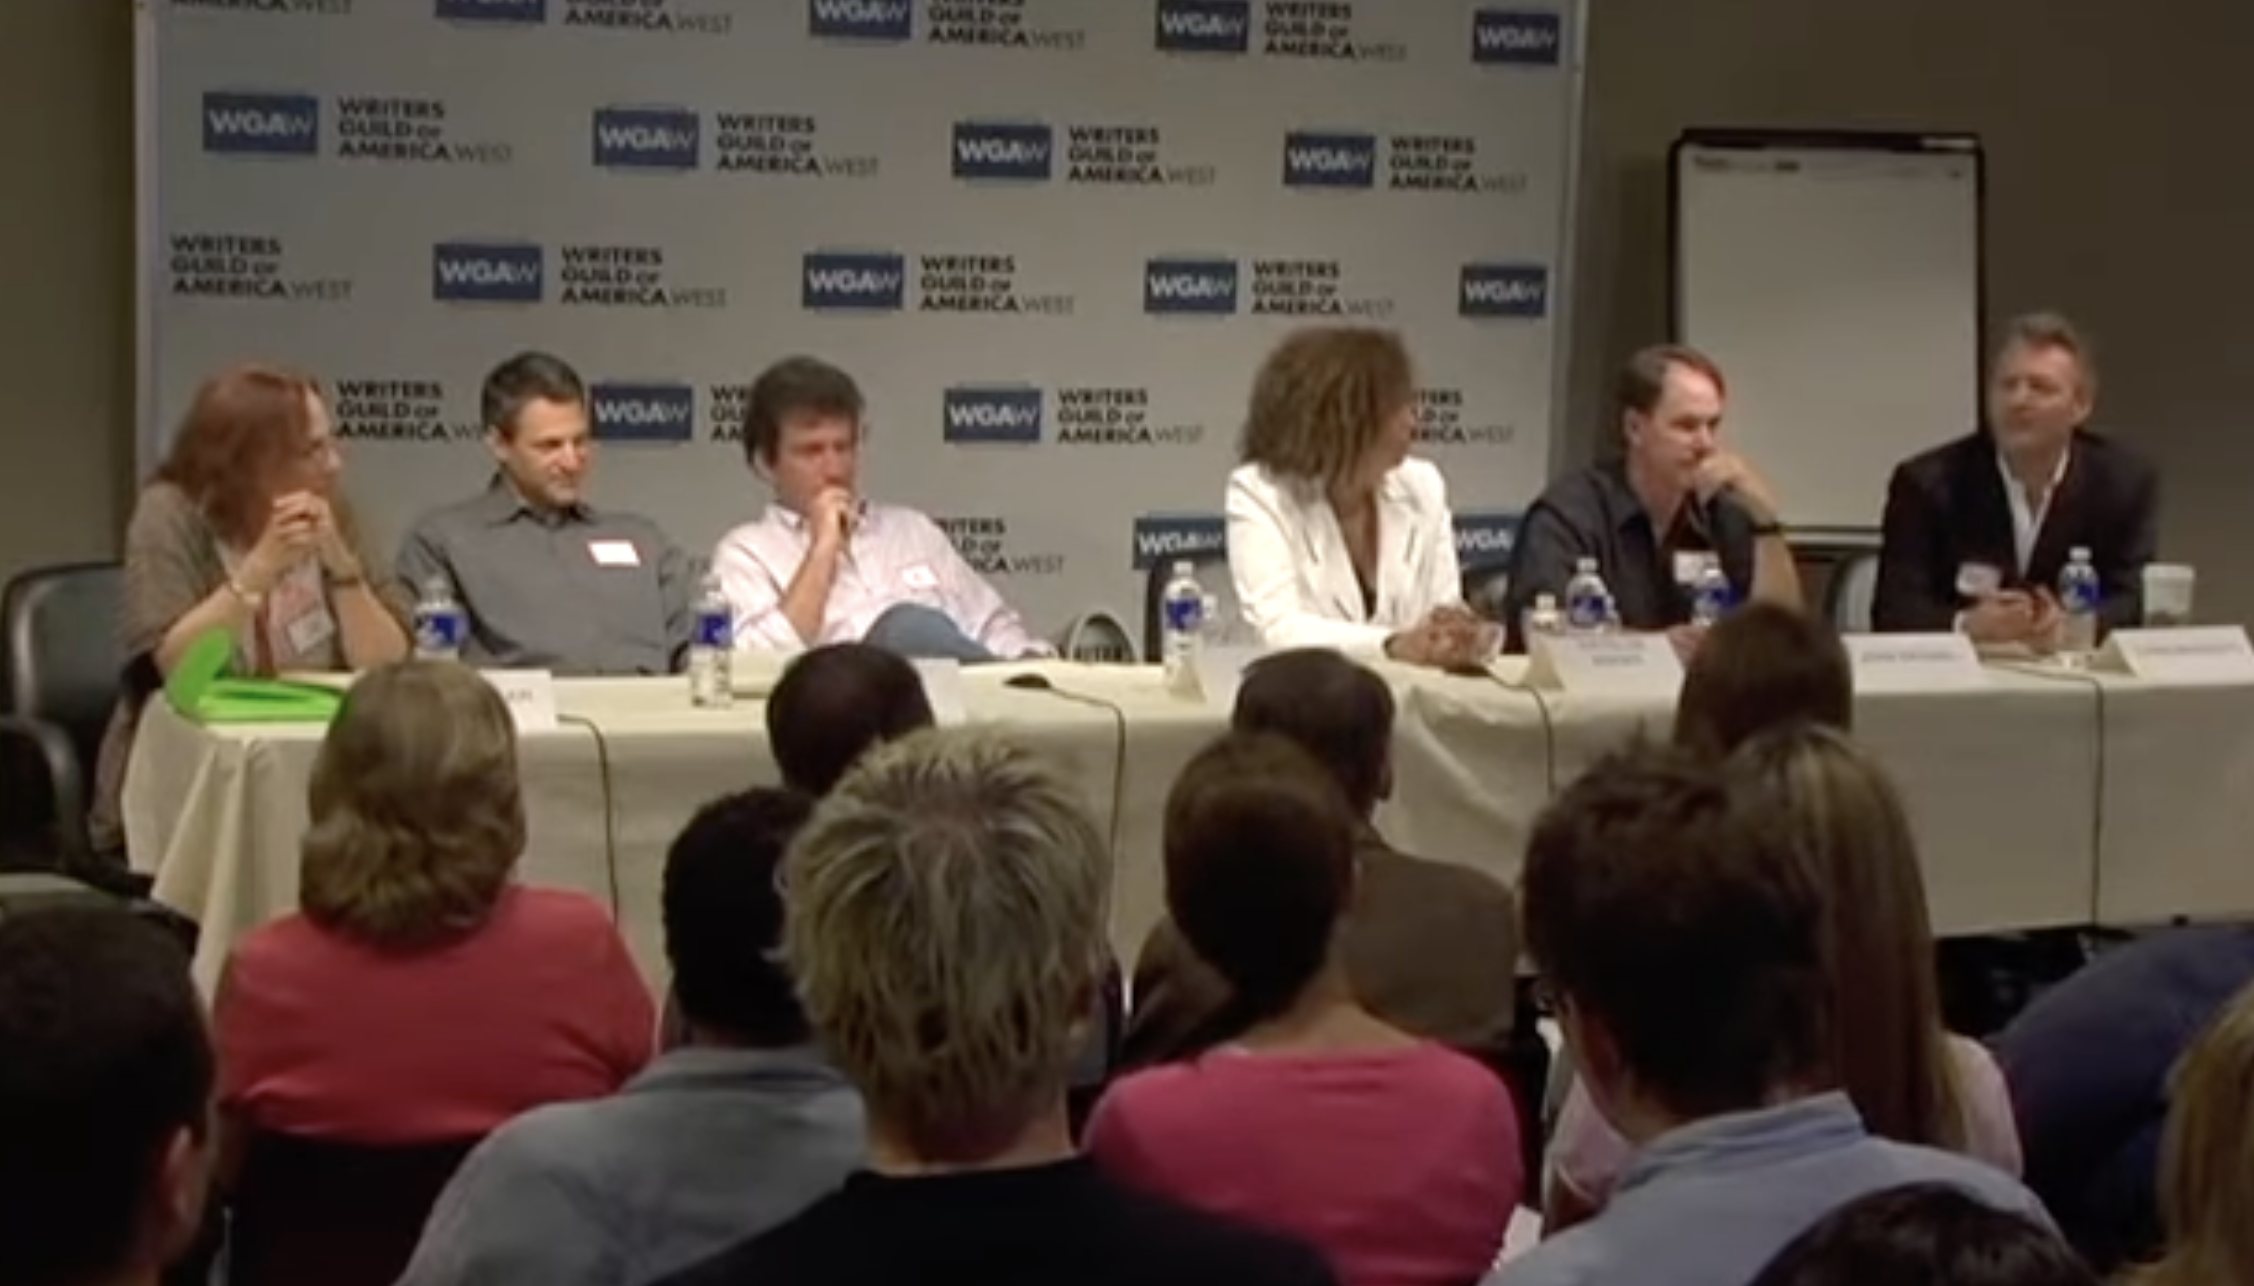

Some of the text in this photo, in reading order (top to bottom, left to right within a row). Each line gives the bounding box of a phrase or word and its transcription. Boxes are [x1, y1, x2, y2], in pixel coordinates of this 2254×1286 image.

[337, 96, 446, 120] WRITERS
[337, 117, 412, 139] GUILD
[717, 112, 816, 134] WRITERS
[717, 132, 786, 152] GUILD
[1069, 125, 1160, 145] WRITERS
[1068, 144, 1134, 163] GUILD
[1389, 136, 1475, 155] WRITERS
[1389, 153, 1449, 172] GUILD
[172, 234, 282, 256] WRITERS
[171, 255, 247, 276] GUILD
[561, 246, 663, 266] WRITERS
[921, 255, 1016, 275] WRITERS
[561, 265, 632, 285] GUILD
[1252, 259, 1341, 280] WRITERS
[920, 273, 988, 293] GUILD
[1252, 278, 1317, 298] GUILD
[337, 380, 442, 400] WRITERS
[1059, 388, 1148, 408] WRITERS
[336, 400, 411, 420] GUILD
[1058, 406, 1122, 426] GUILD
